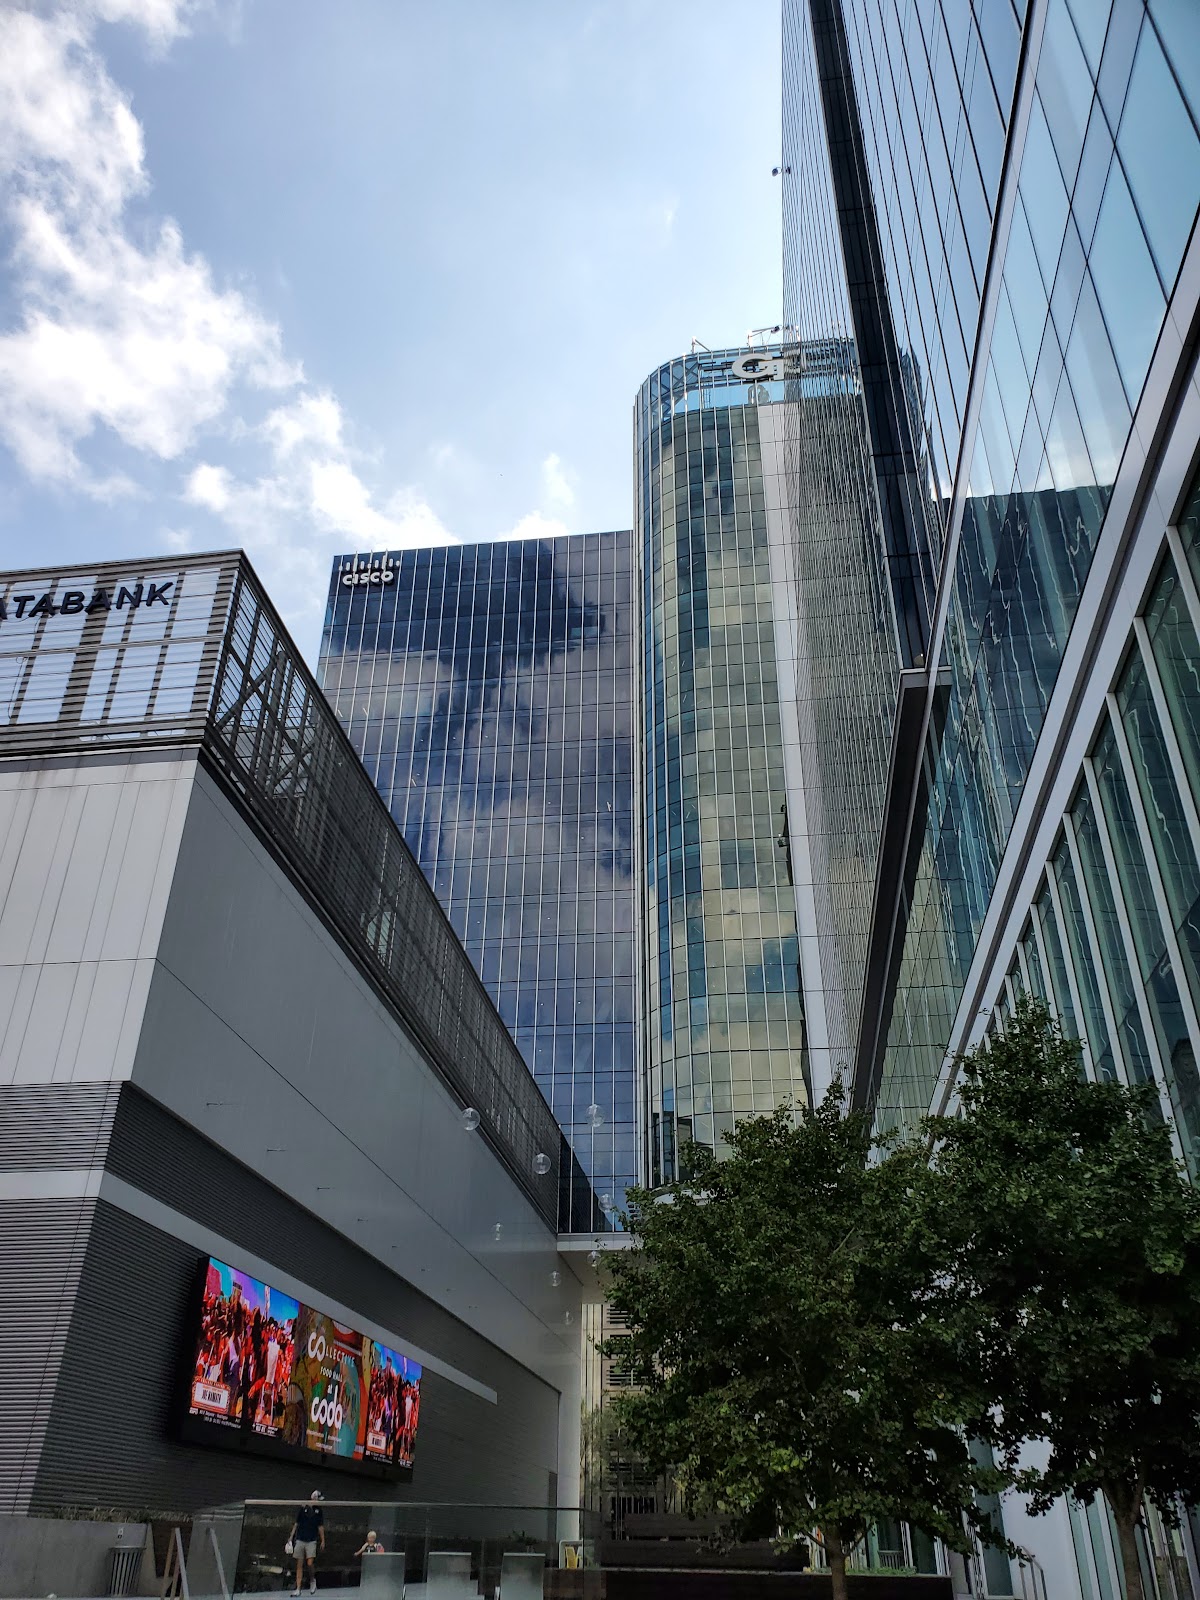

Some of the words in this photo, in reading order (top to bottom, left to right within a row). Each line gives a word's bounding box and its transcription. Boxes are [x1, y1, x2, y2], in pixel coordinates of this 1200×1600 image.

[342, 571, 394, 586] cisco
[320, 1366, 332, 1379] FOOD
[311, 1384, 343, 1430] coda
